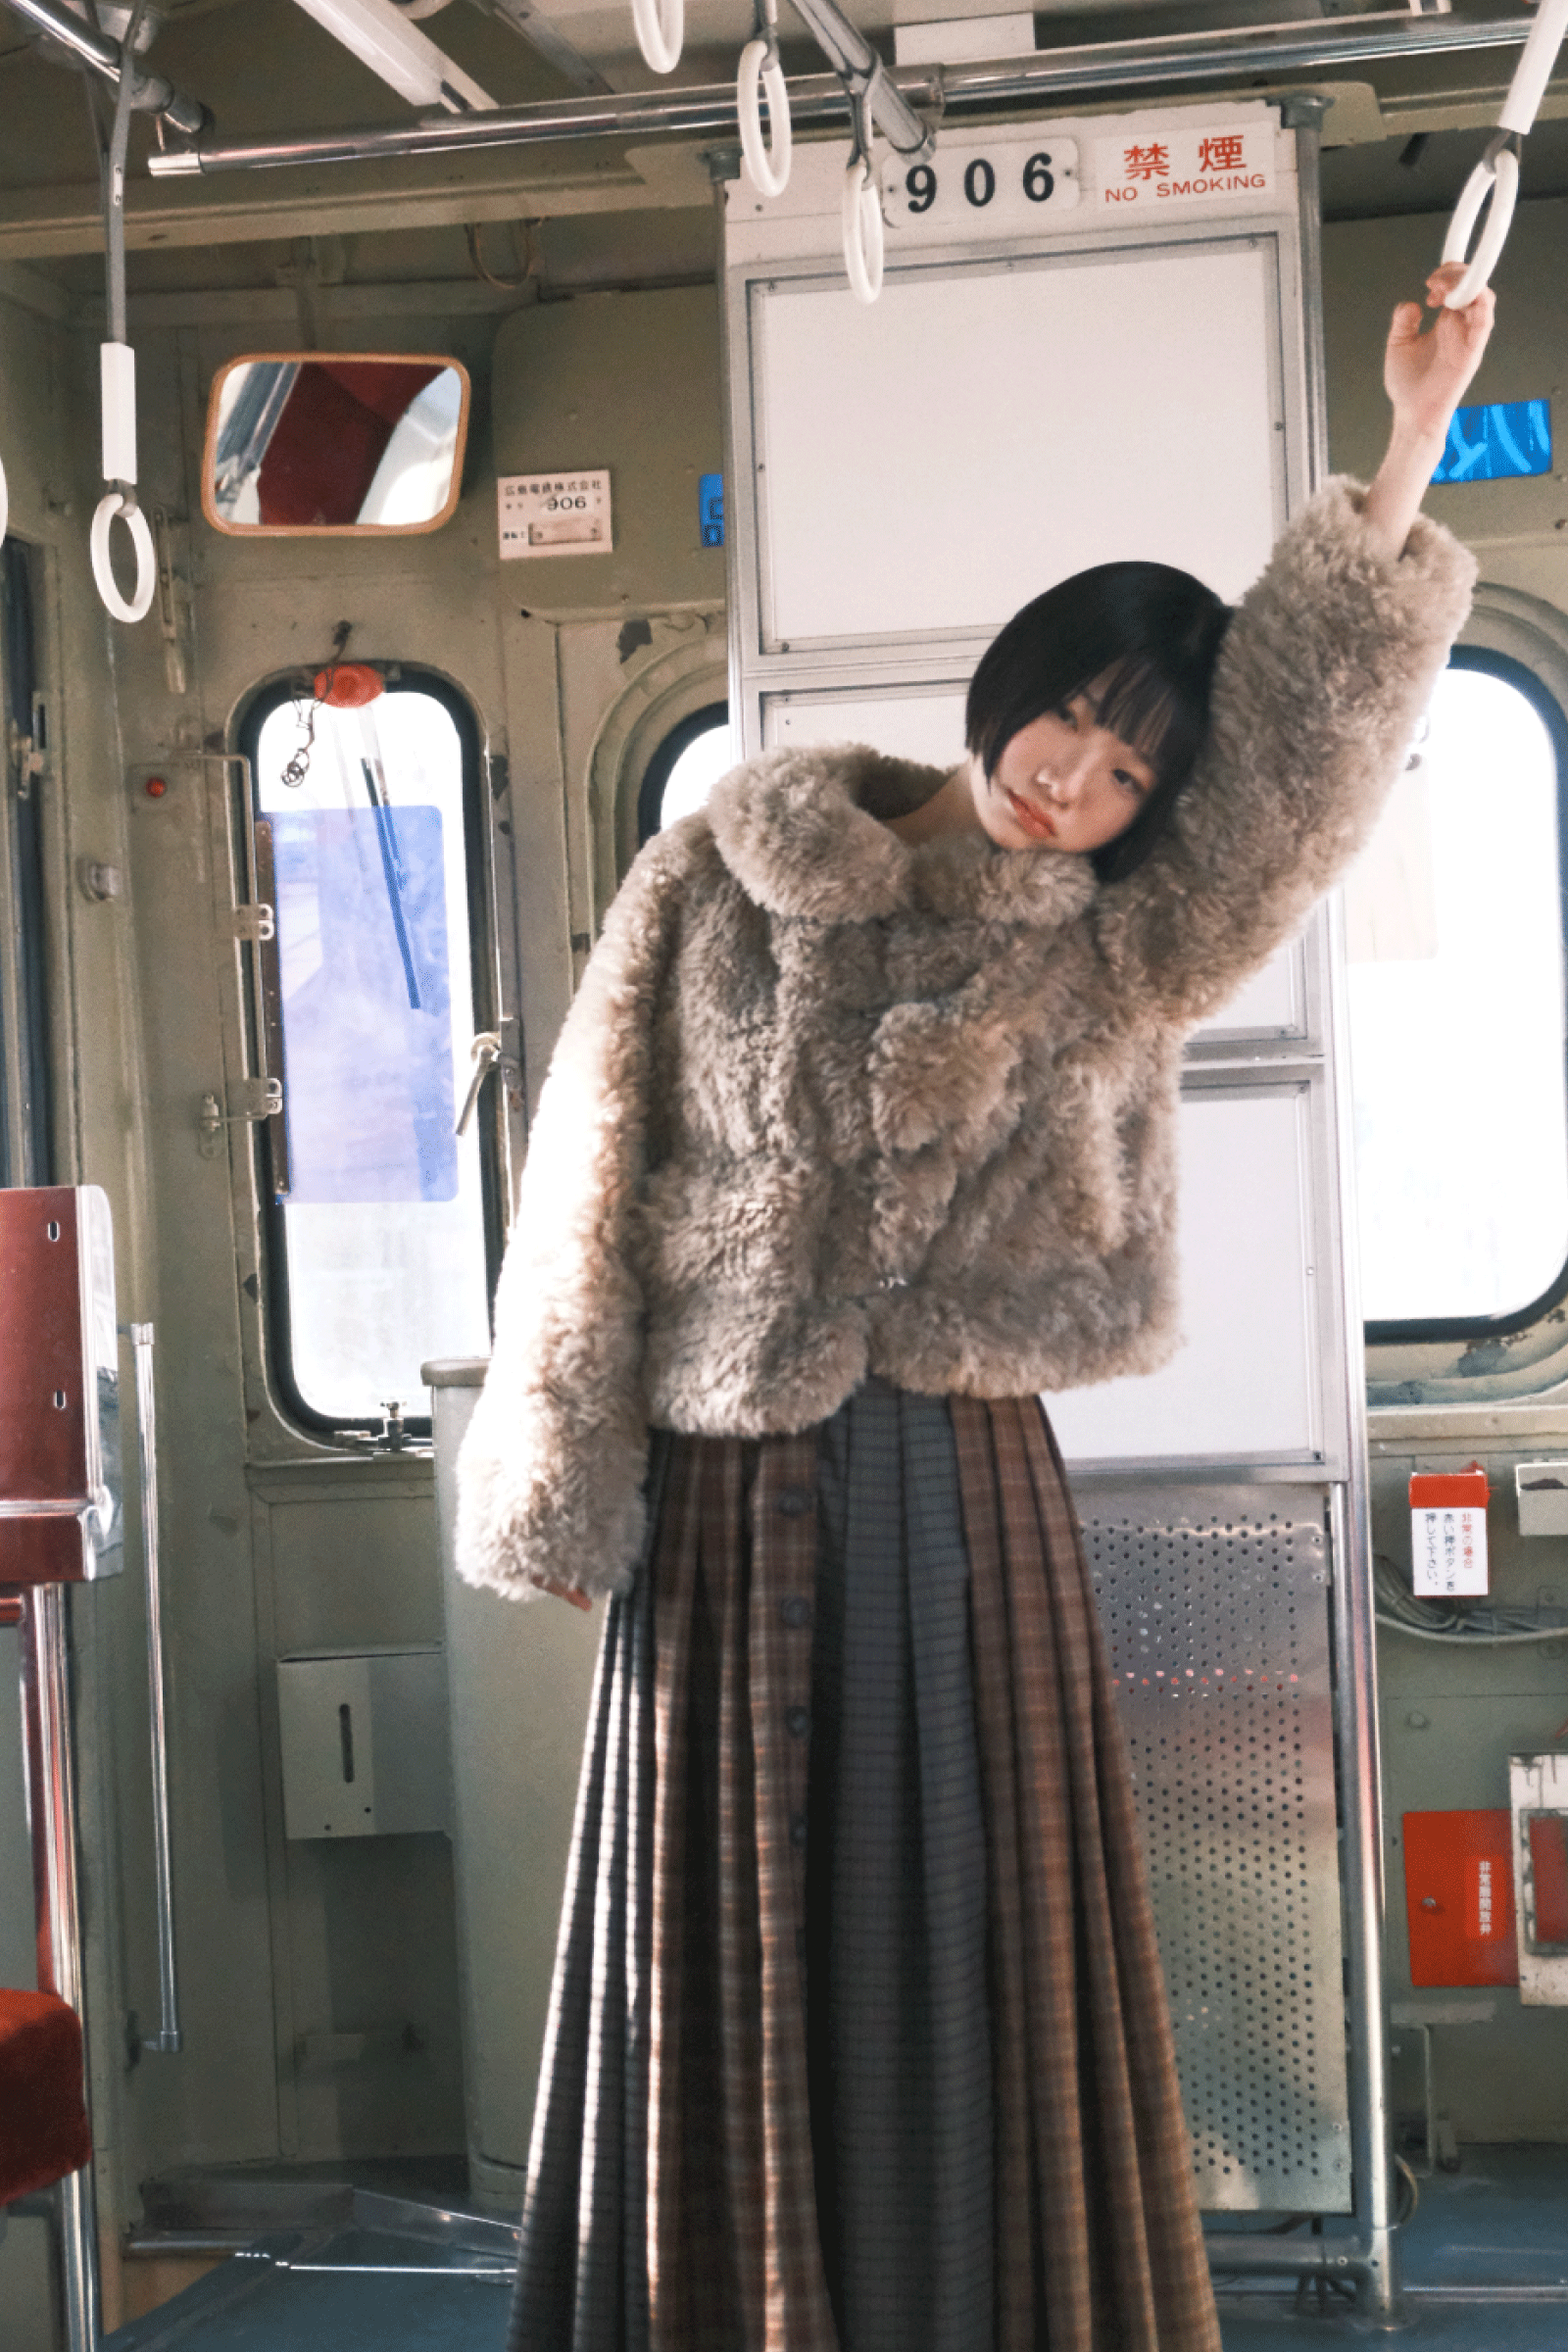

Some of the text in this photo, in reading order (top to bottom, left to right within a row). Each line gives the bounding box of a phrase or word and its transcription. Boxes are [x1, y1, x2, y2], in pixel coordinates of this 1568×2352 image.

[1123, 134, 1247, 180] 禁煙
[904, 152, 1055, 213] 906
[1104, 173, 1266, 203] NO SMOKING
[547, 496, 586, 511] 906
[1462, 1512, 1473, 1568] 非常の場合
